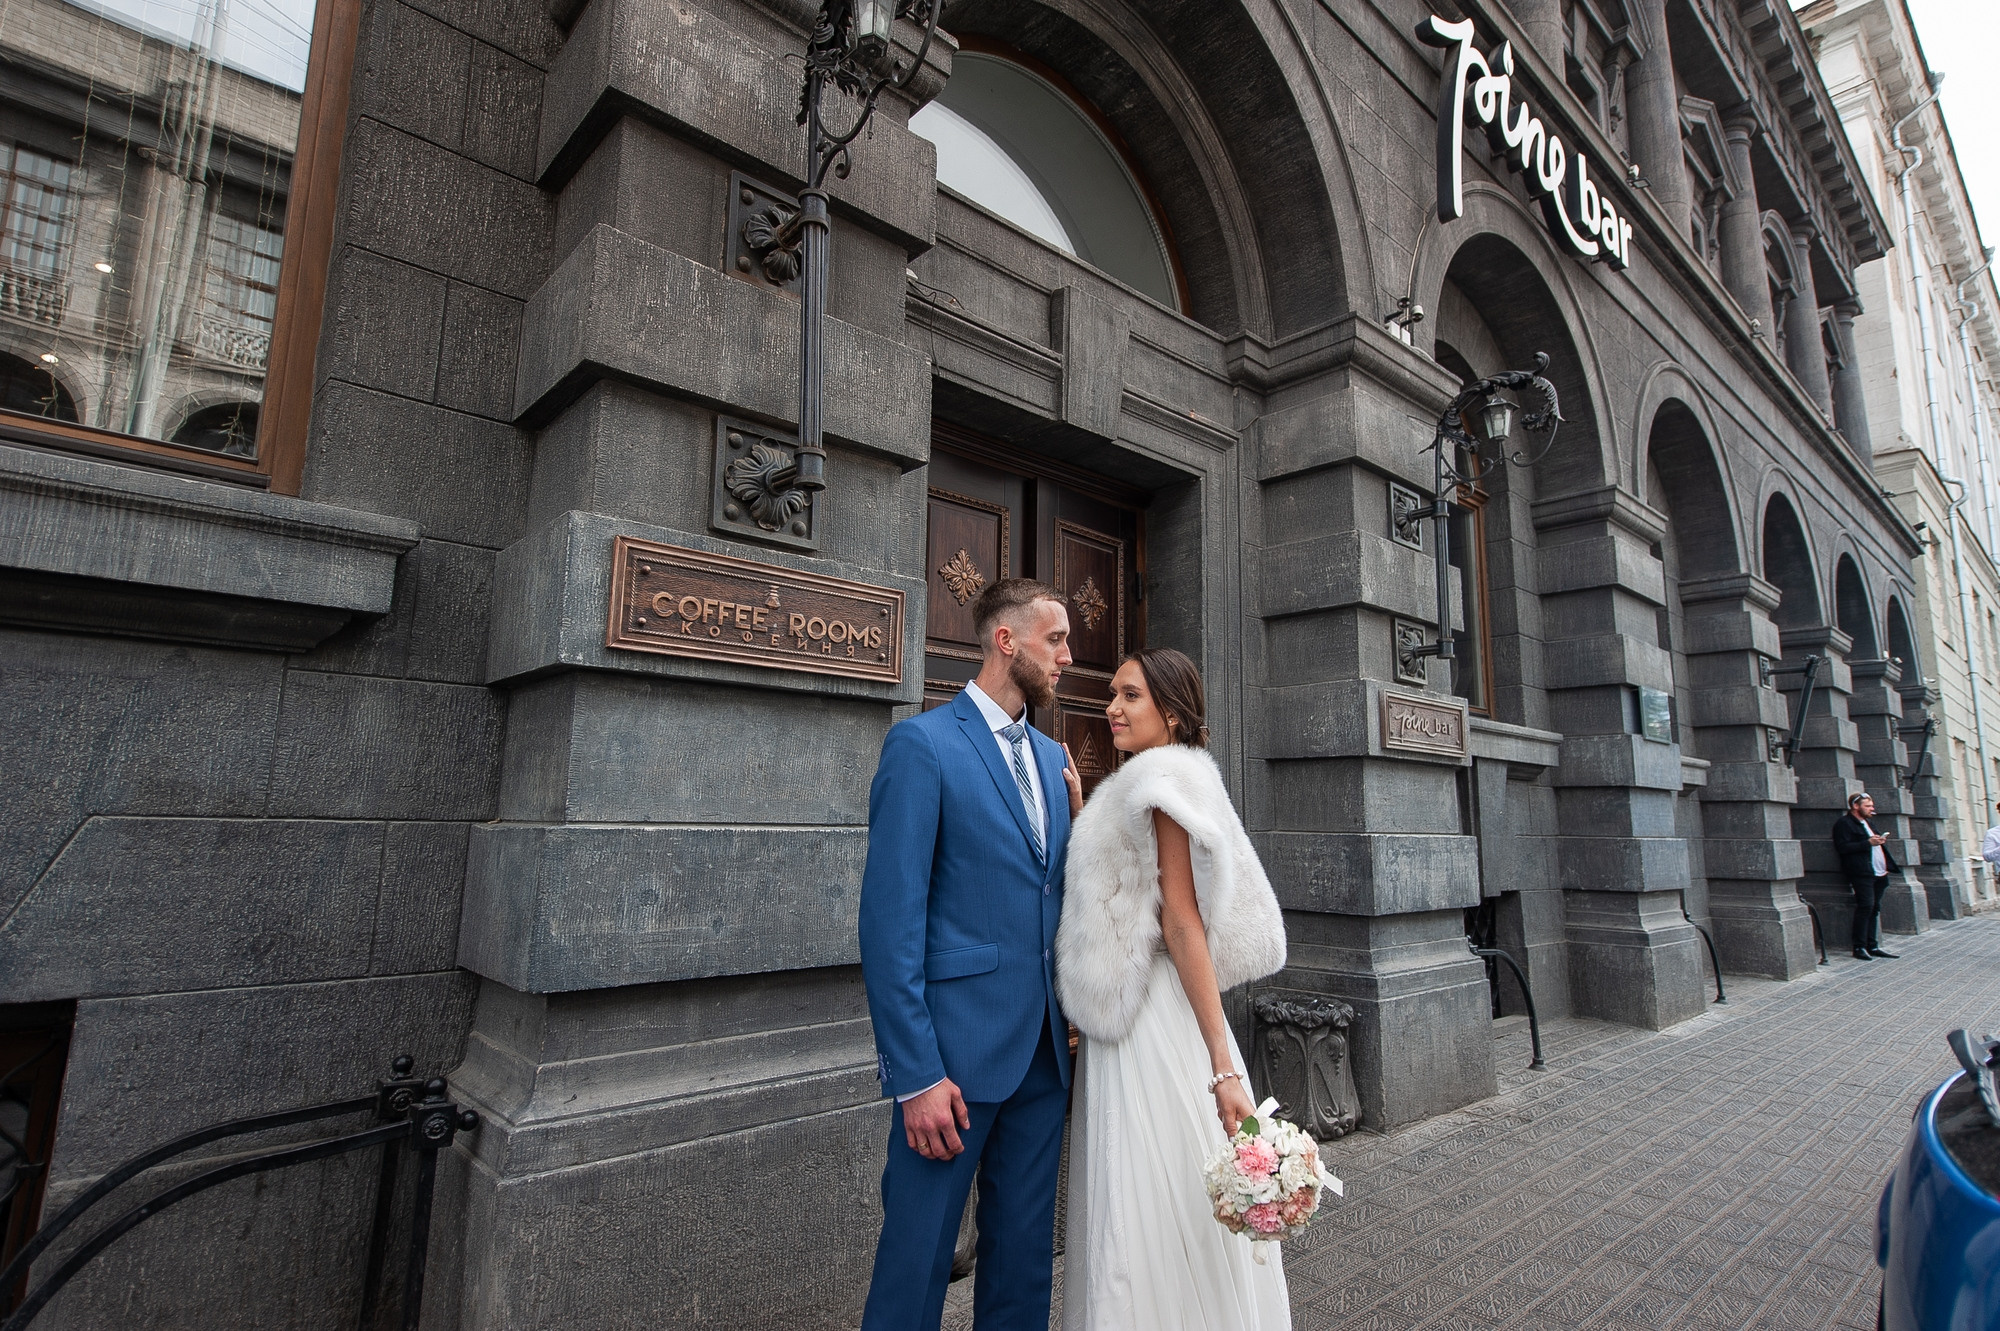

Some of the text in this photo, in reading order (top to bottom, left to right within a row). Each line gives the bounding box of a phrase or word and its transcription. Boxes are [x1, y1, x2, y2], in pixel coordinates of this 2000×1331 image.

[1577, 152, 1633, 268] bar
[651, 591, 883, 650] COFFEE ROOMS
[1434, 717, 1454, 735] bar
